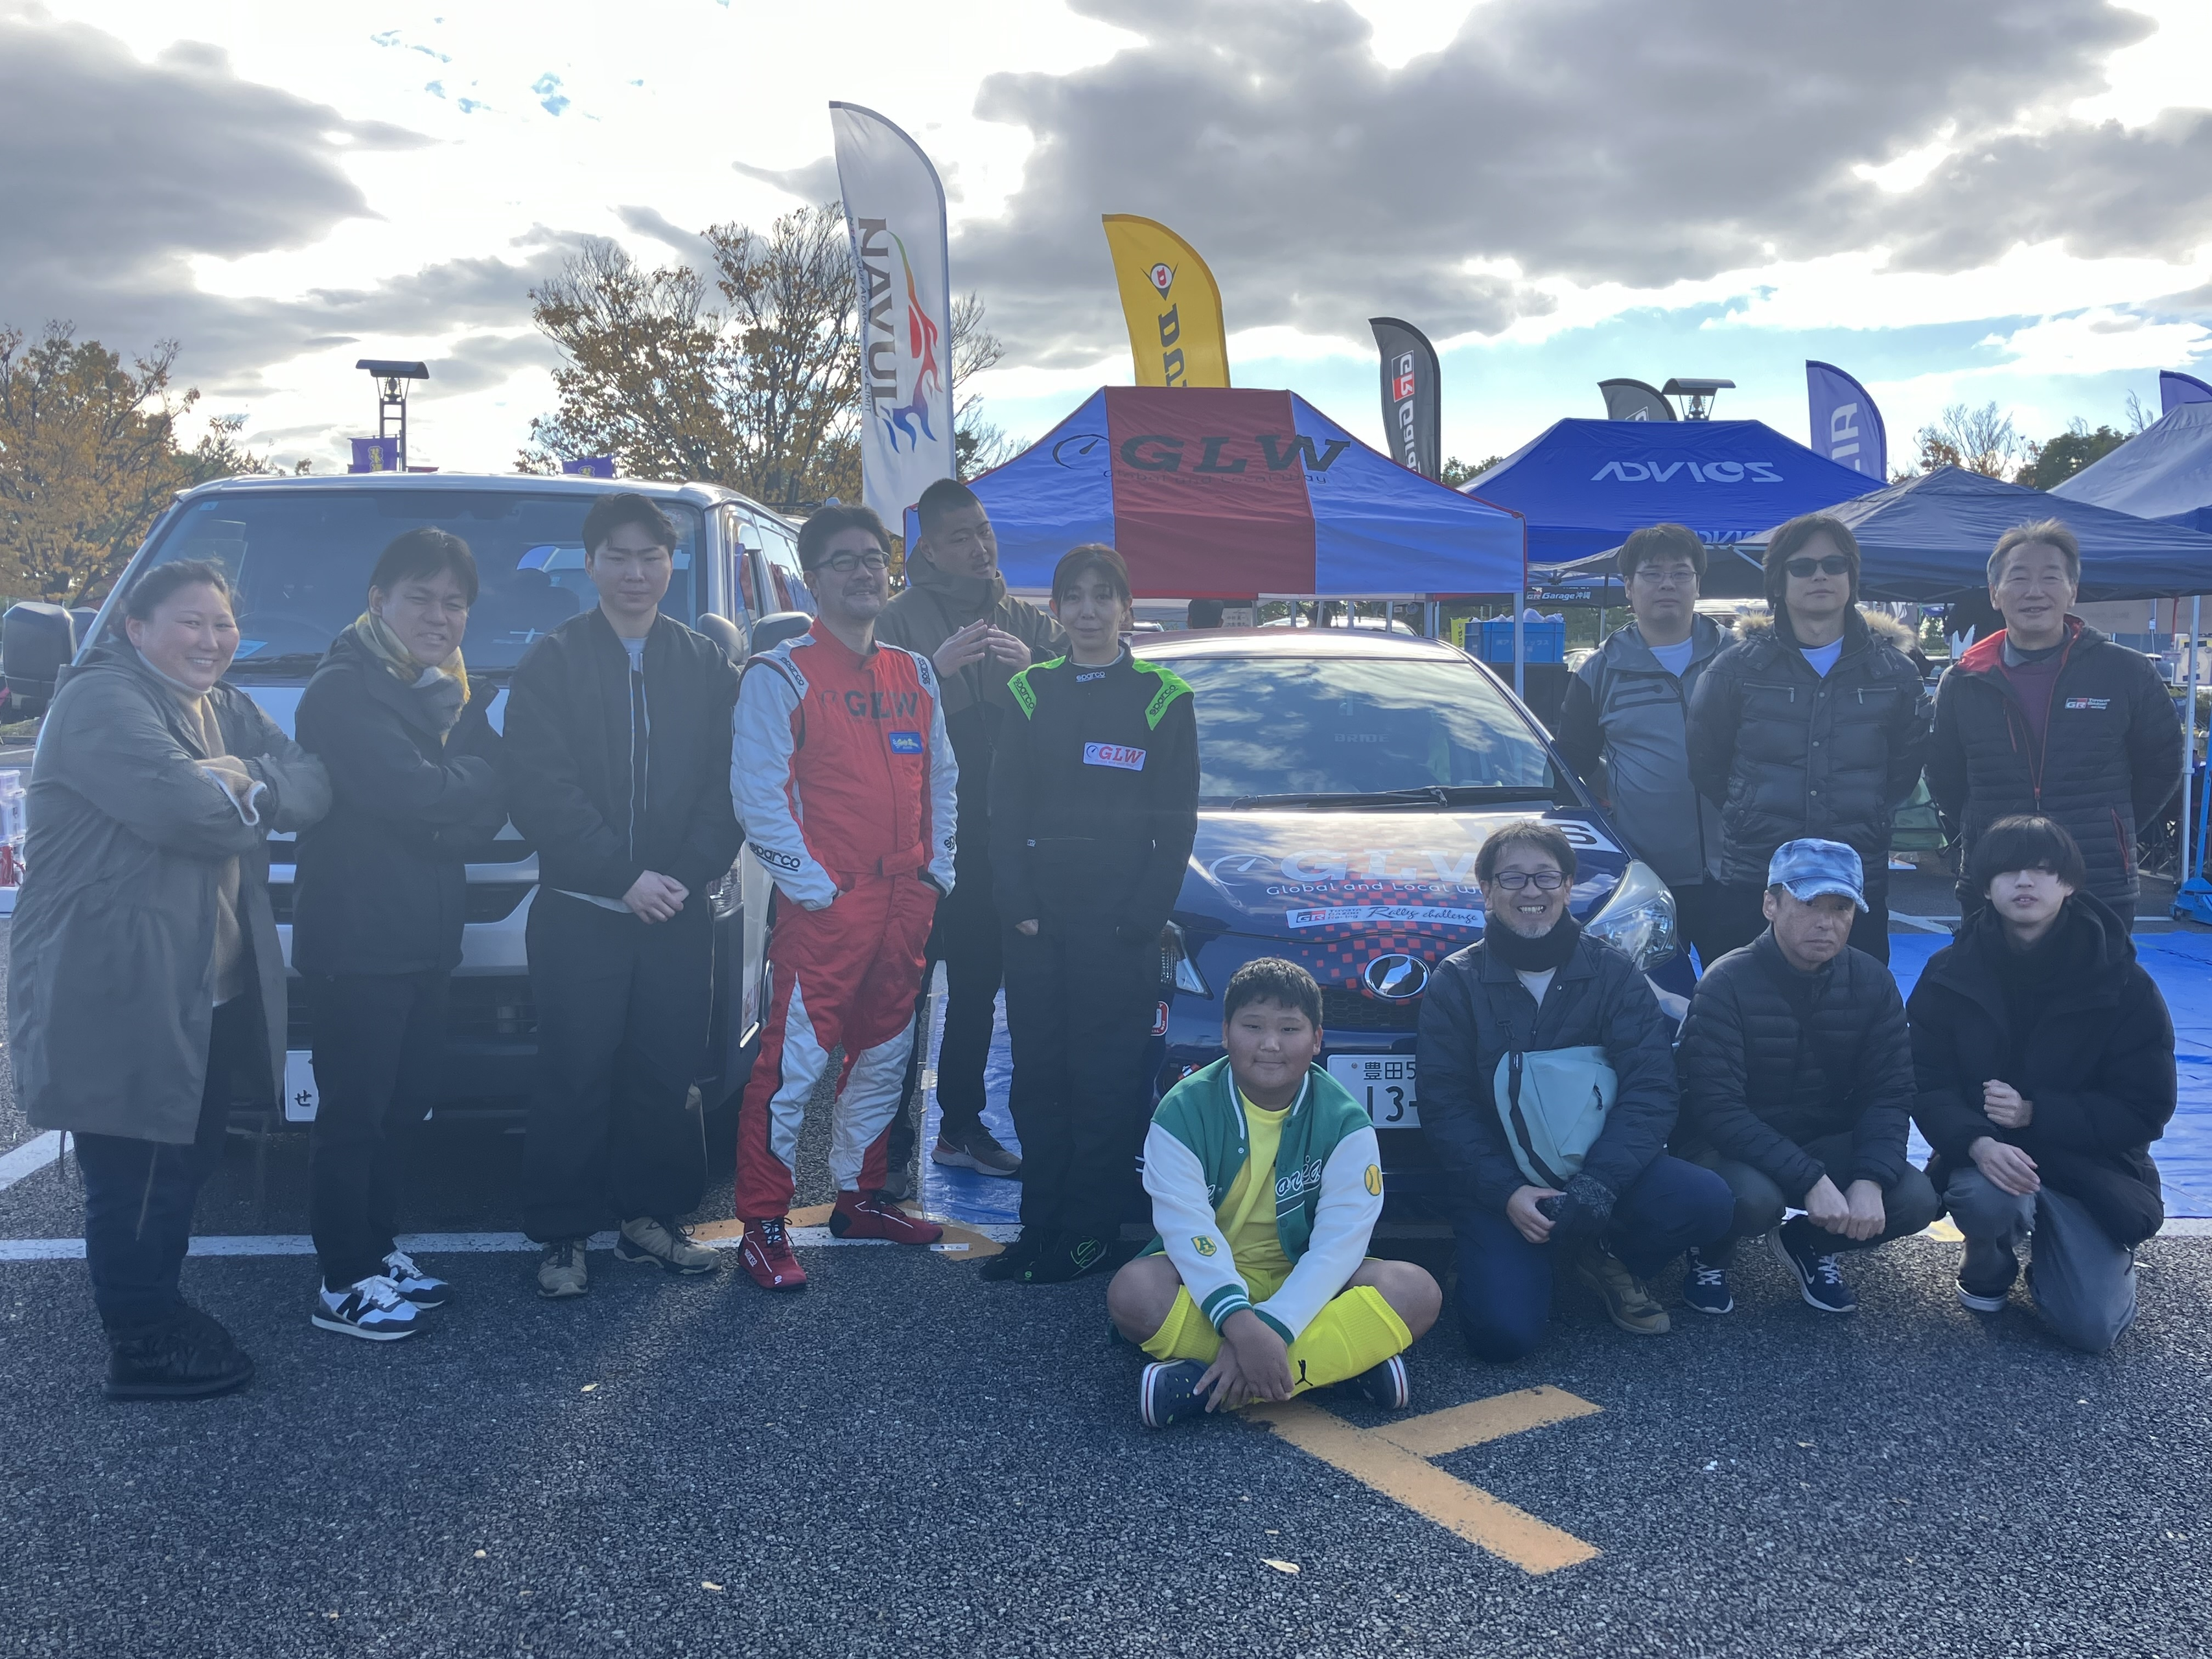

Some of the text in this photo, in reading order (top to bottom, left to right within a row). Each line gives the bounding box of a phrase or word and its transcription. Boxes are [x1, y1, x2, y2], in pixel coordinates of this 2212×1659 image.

[1119, 434, 1351, 473] GLW
[1590, 461, 1784, 483] ADVICS
[1542, 592, 1575, 601] Garage
[1077, 671, 1106, 682] sparco
[1014, 678, 1035, 710] sparco
[1149, 684, 1178, 716] sparco
[844, 690, 918, 719] GLW
[1334, 734, 1390, 743] BRIDE
[1099, 746, 1144, 763] GLW
[749, 842, 801, 870] sparco
[1266, 882, 1336, 896] Global
[1344, 882, 1384, 891] and
[1392, 883, 1447, 893] Local
[1367, 906, 1419, 920] Rally
[294, 1089, 312, 1108] せ
